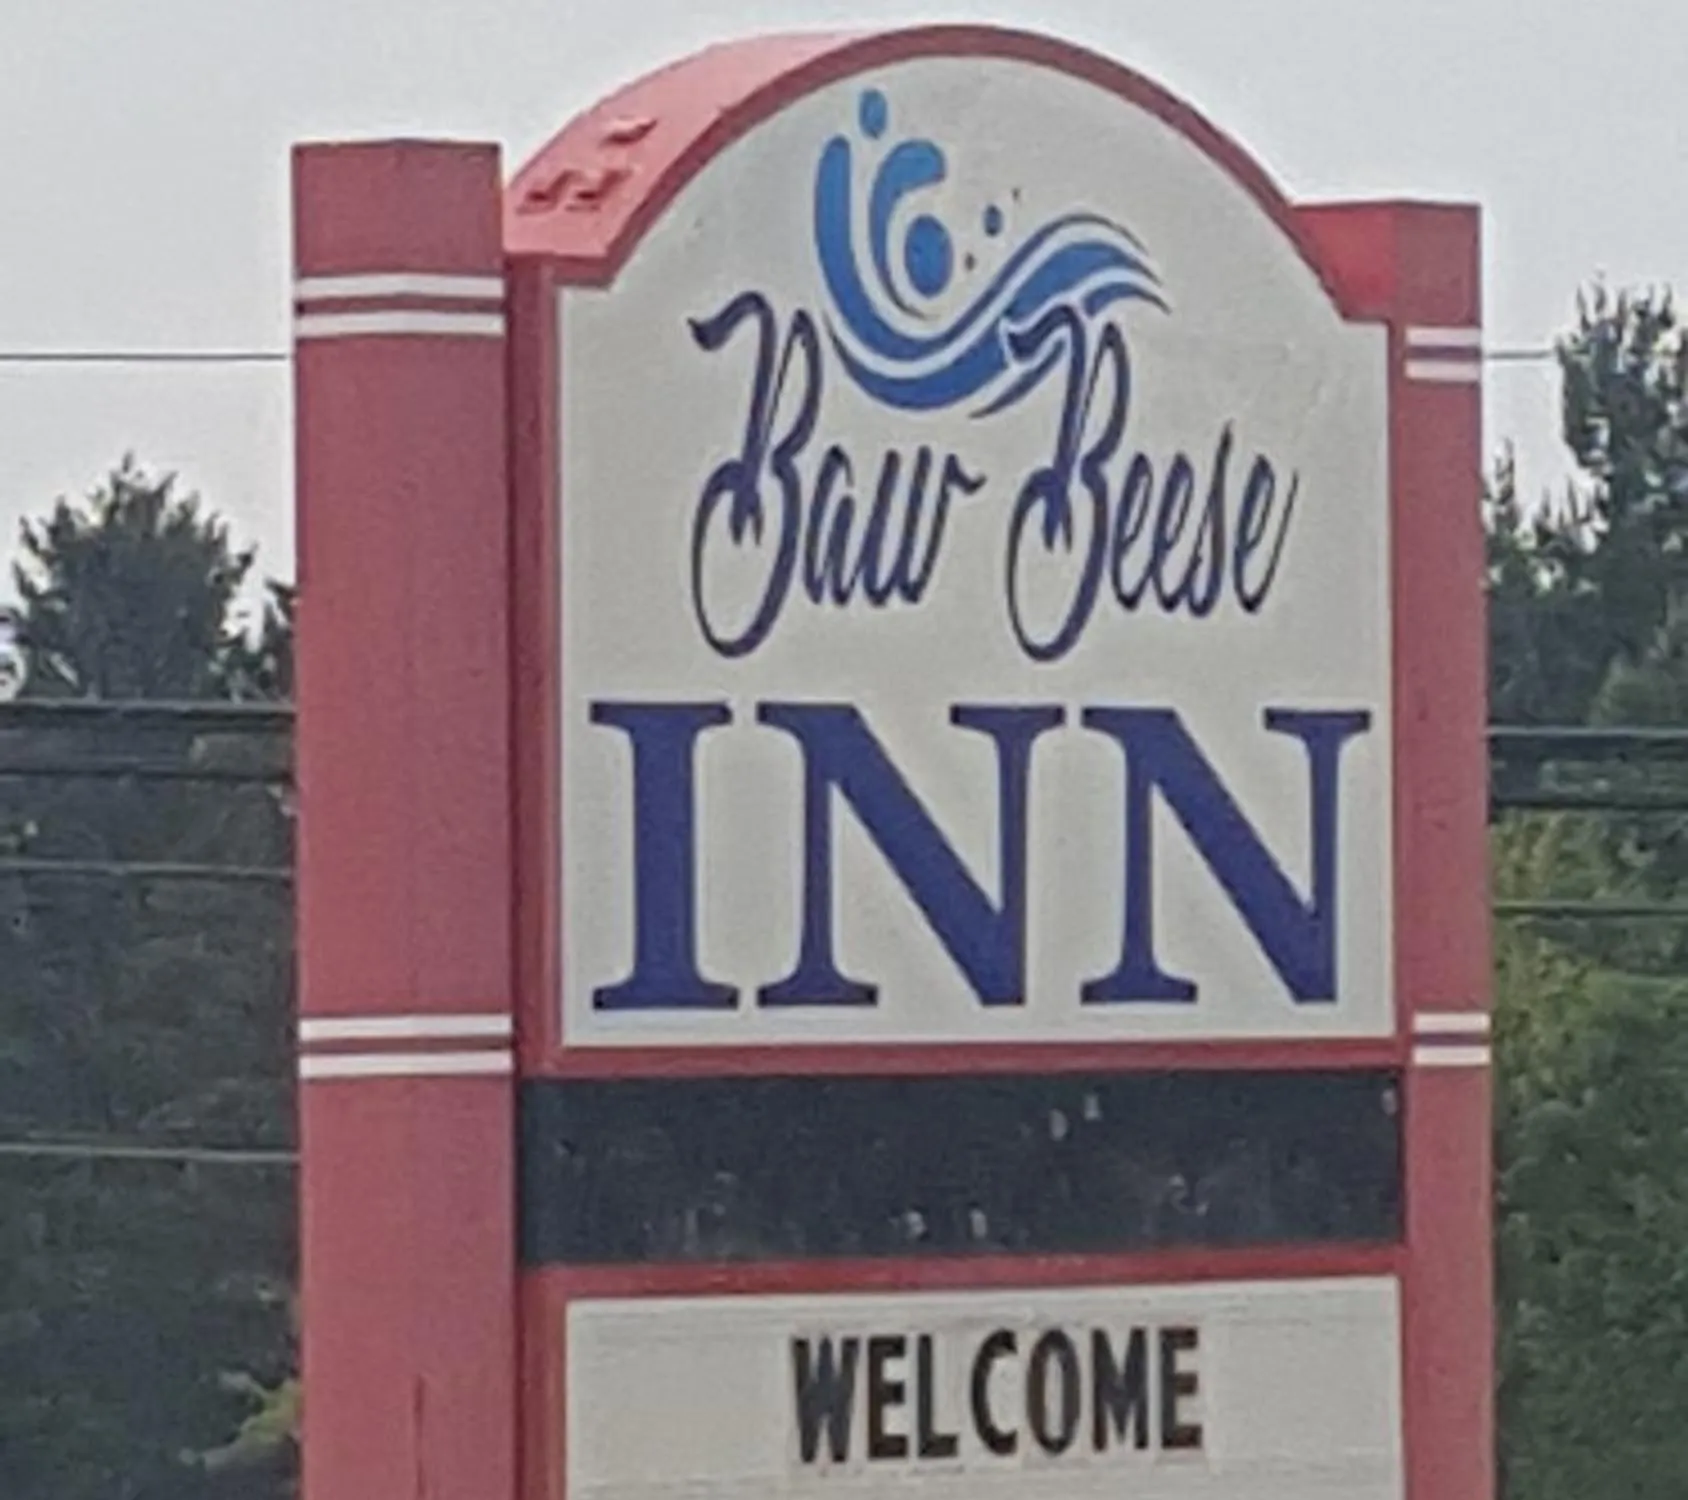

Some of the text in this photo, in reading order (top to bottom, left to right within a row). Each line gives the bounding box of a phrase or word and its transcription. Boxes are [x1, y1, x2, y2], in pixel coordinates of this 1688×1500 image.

[687, 291, 1299, 662] Baw Beese
[589, 700, 1372, 1011] INN
[792, 1326, 1205, 1465] WELCOME
